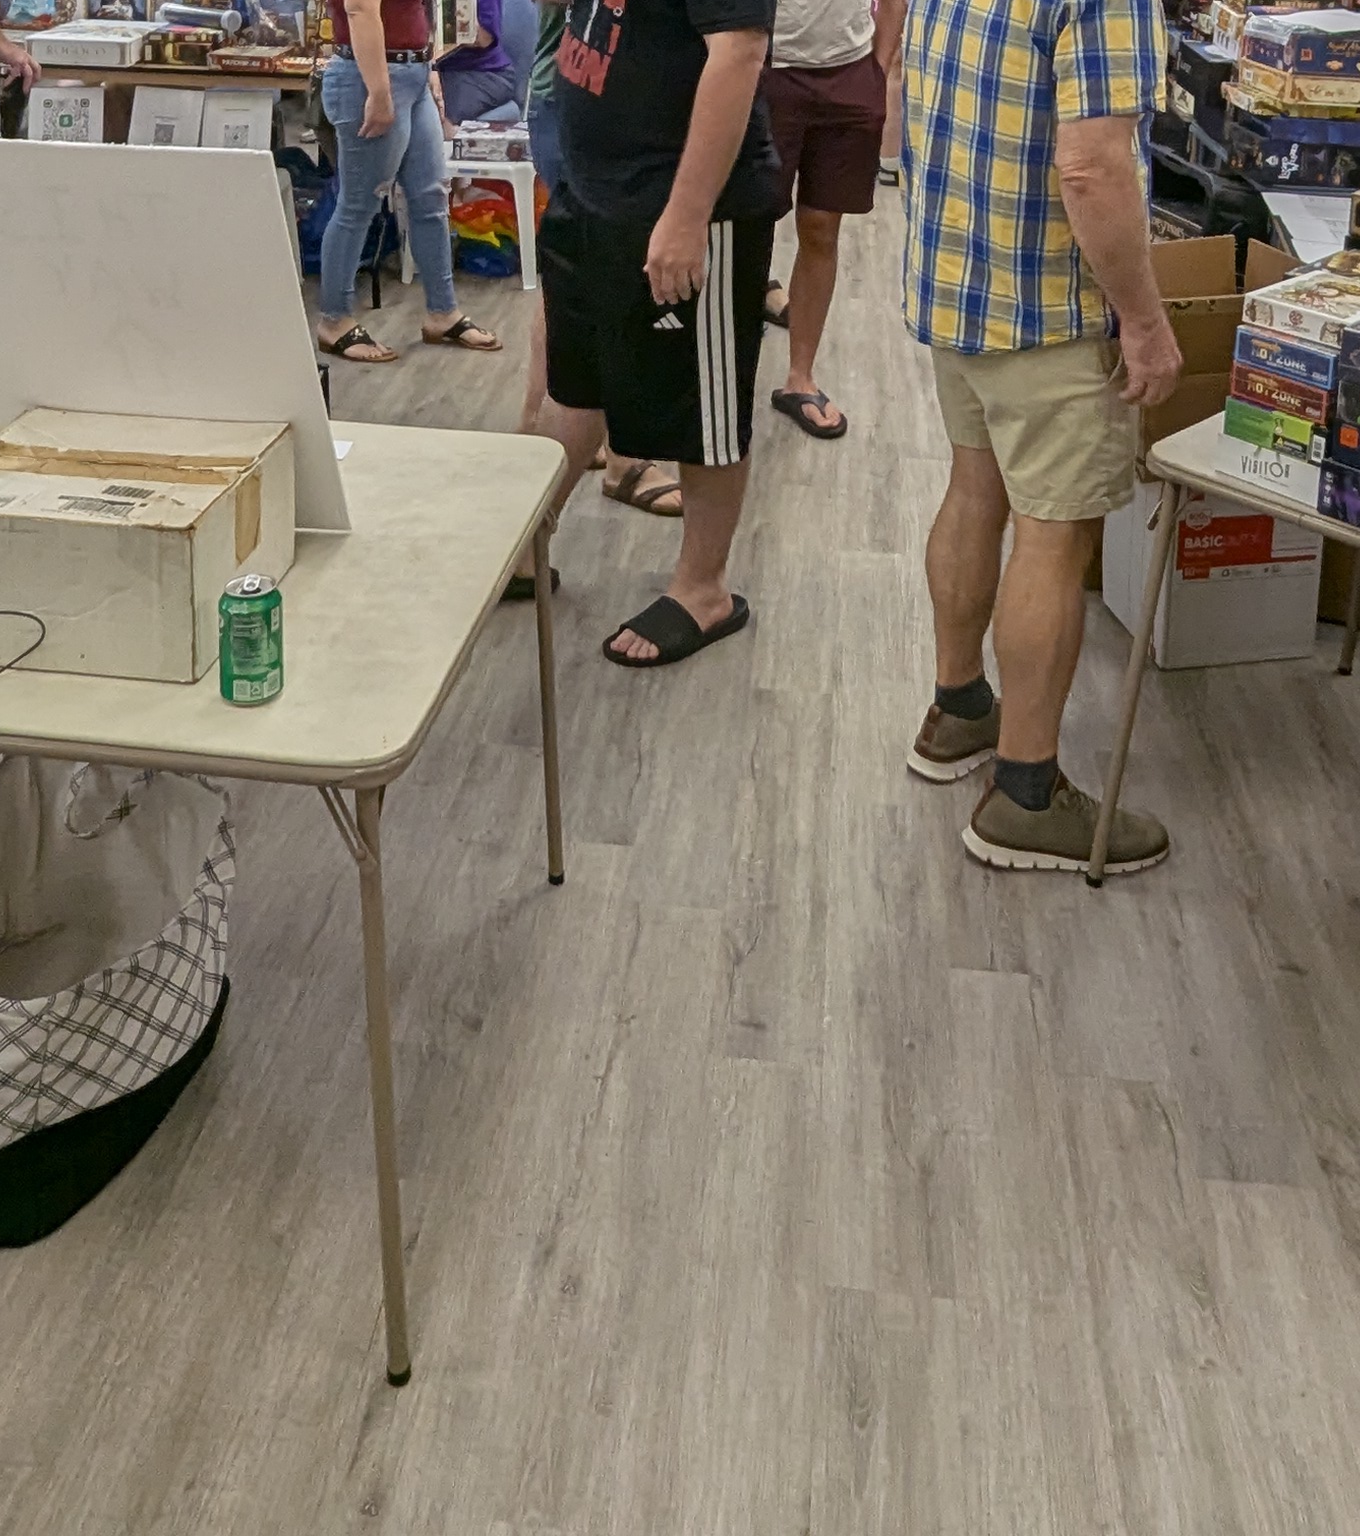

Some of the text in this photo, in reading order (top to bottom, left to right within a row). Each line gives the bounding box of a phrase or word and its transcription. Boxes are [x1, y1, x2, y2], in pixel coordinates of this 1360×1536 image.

[1275, 356, 1307, 372] ZONE
[1271, 389, 1302, 407] ZONE
[1241, 455, 1290, 478] VISITOR
